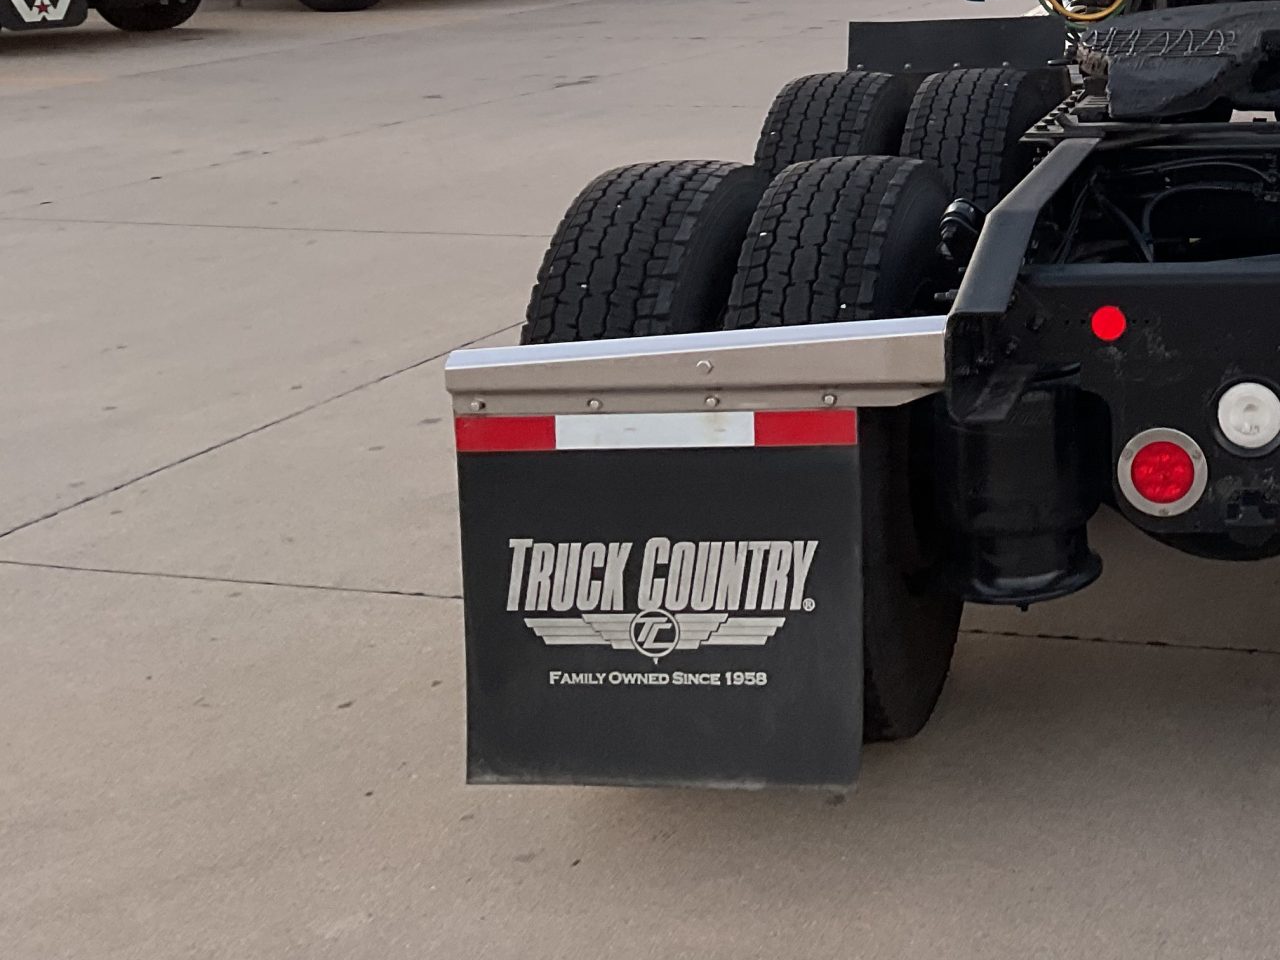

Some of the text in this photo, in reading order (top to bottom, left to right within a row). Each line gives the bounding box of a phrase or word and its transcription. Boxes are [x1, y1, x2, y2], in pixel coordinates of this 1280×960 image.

[506, 538, 634, 612] TRUCK
[549, 670, 768, 686] FAMILY OWNED SINCE 1958
